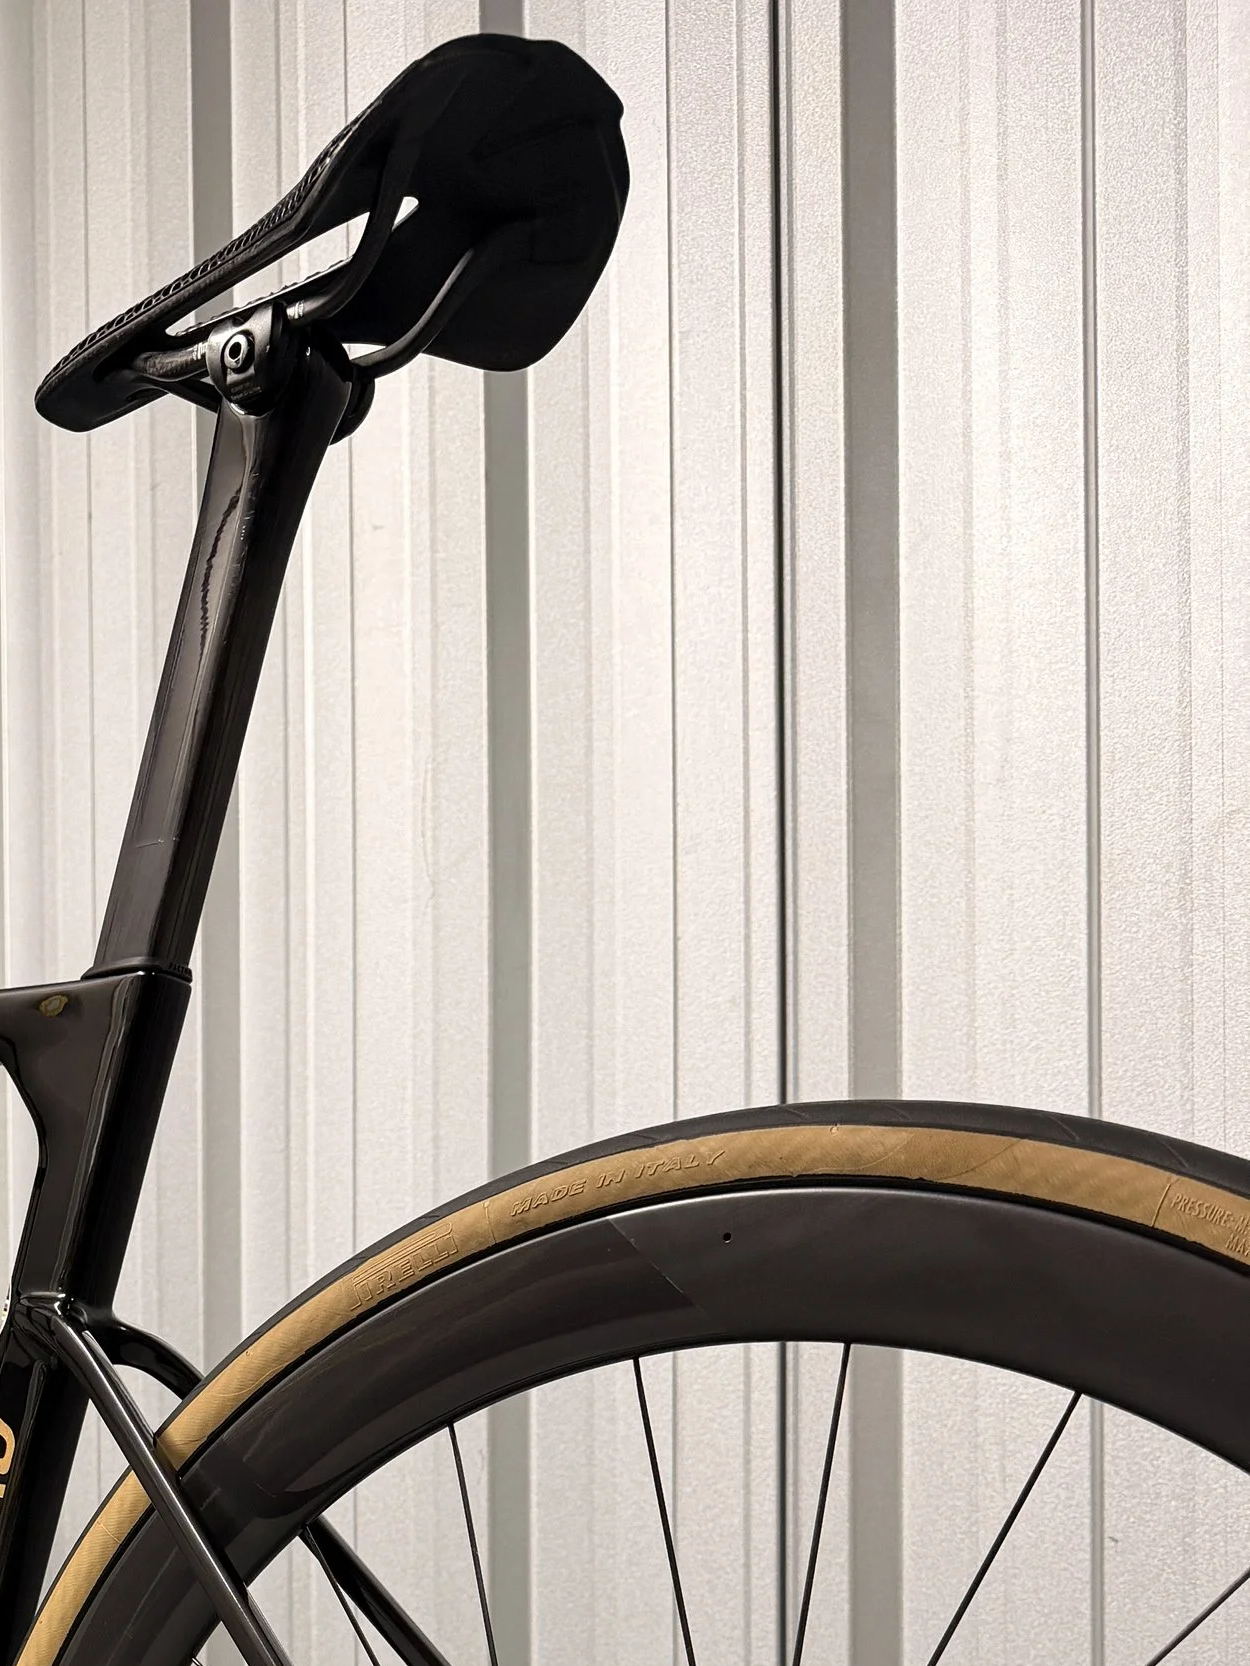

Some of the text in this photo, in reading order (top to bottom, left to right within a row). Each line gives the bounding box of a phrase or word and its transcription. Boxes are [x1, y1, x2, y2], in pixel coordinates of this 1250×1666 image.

[510, 1148, 727, 1218] MADE IN ITALY
[350, 1219, 460, 1308] PIRELLI
